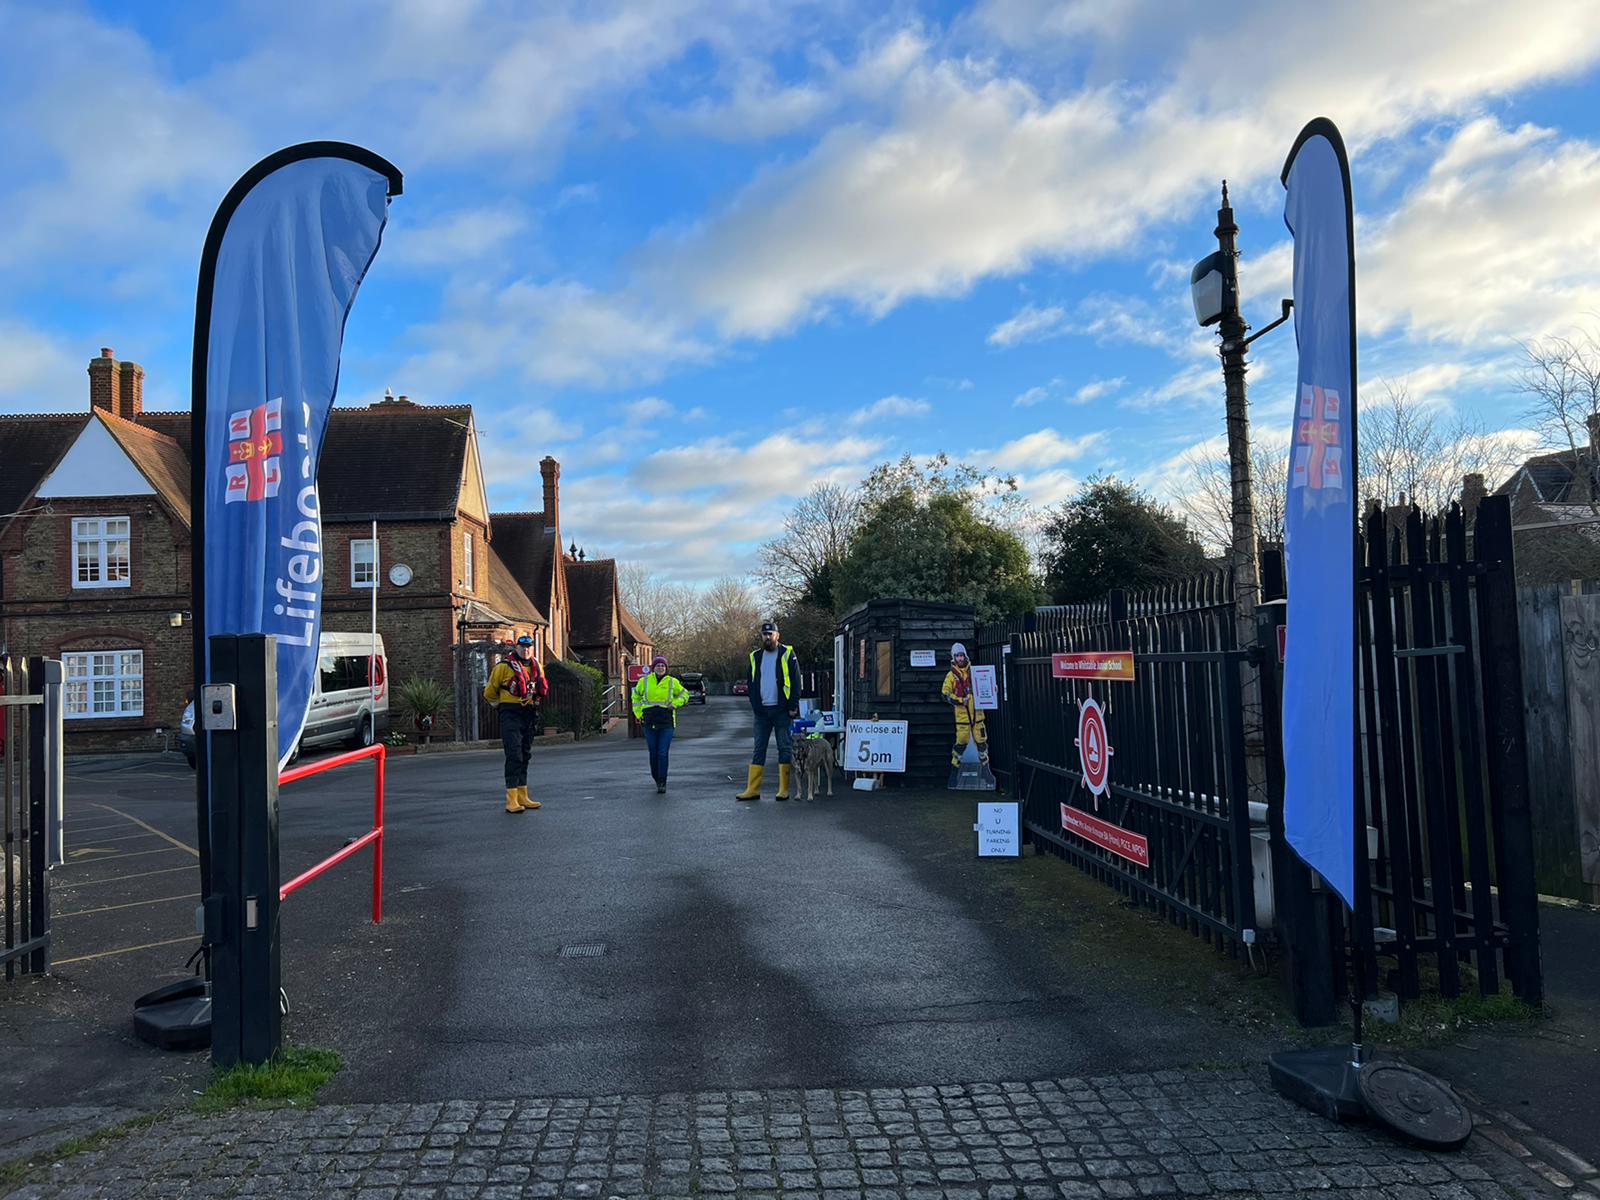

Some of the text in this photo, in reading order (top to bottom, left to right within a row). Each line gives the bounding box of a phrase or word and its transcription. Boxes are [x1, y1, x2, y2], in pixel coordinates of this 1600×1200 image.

[273, 401, 322, 647] Lifebo
[850, 725, 903, 734] We close at:
[858, 740, 892, 766] 5pm
